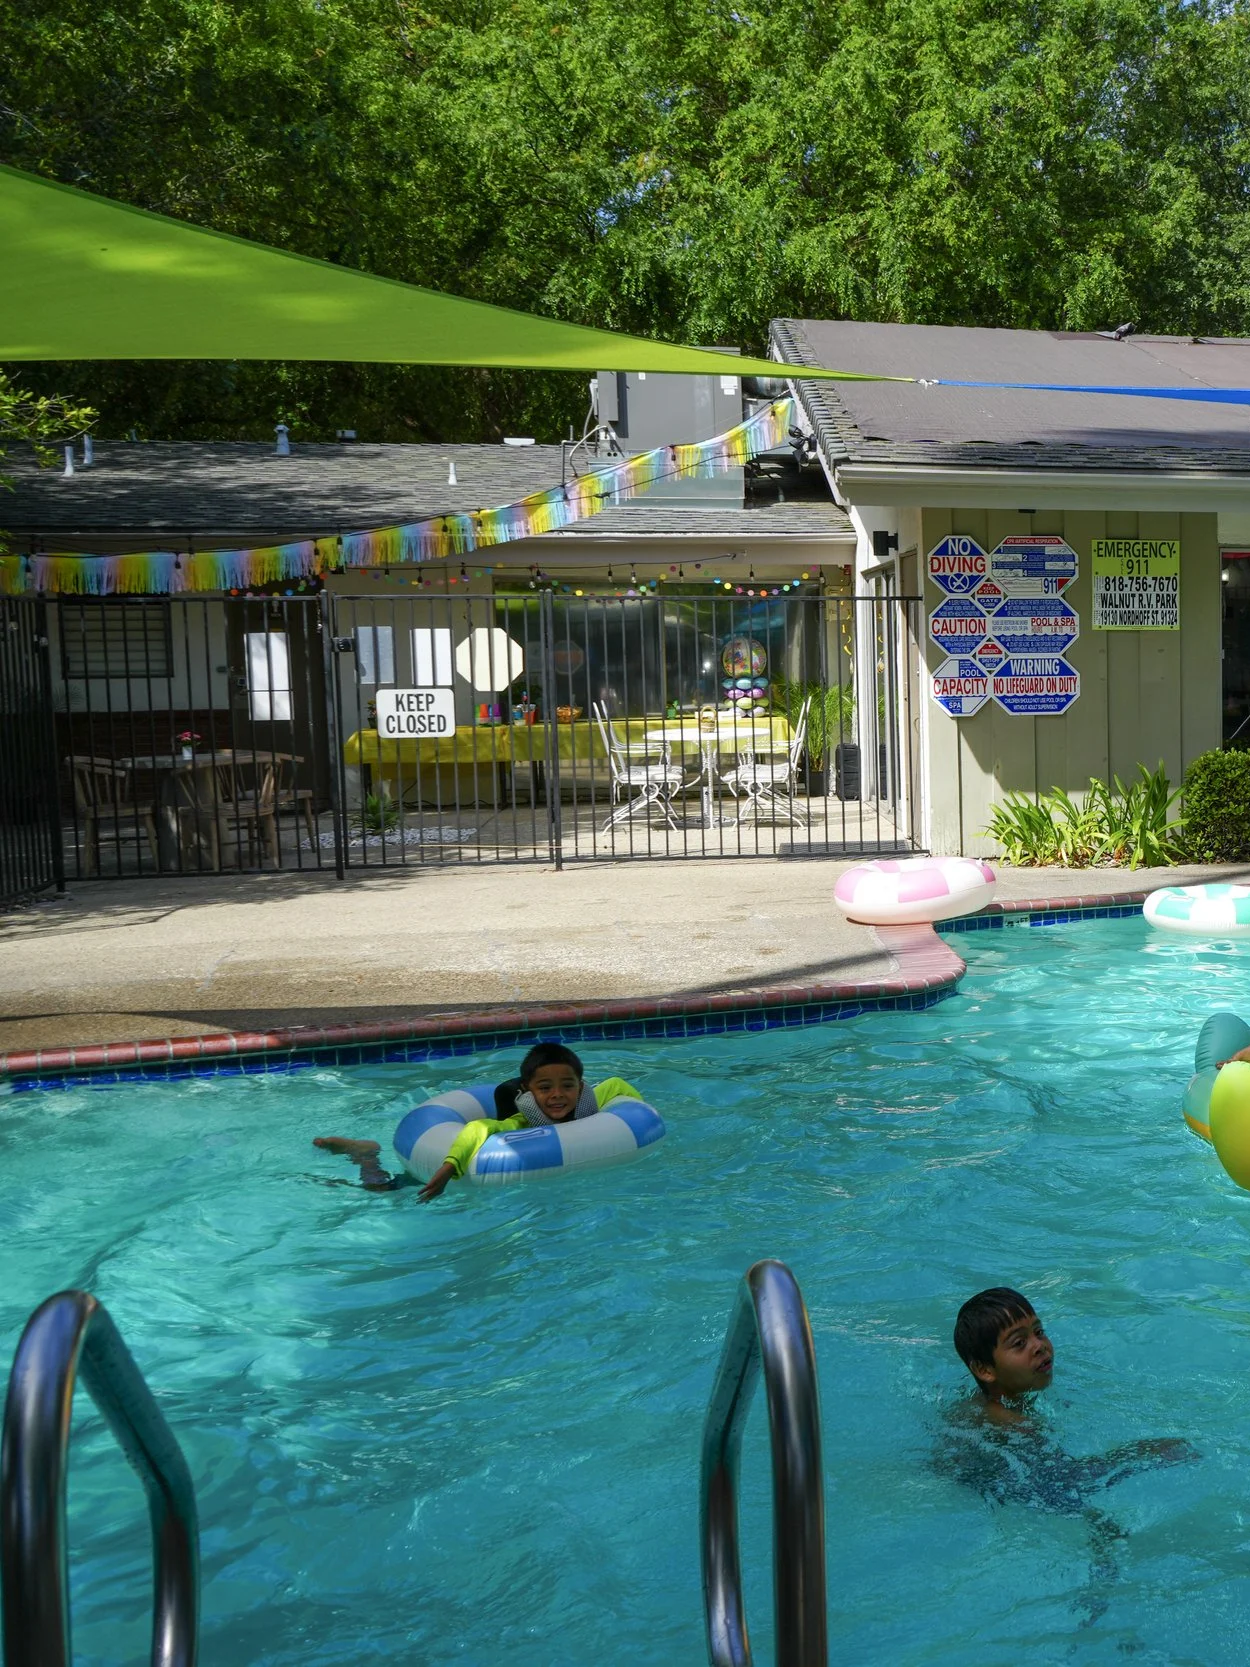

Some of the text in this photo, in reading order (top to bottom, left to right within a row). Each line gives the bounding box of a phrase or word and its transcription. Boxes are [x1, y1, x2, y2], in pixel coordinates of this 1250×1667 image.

[948, 538, 971, 555] NO
[1096, 541, 1175, 558] EMERGENCY
[930, 556, 986, 573] DIVING
[1126, 559, 1149, 575] 911
[1043, 577, 1058, 595] 911
[1104, 576, 1178, 592] 818-756-7670
[1100, 593, 1136, 609] WALNUT
[1138, 593, 1154, 609] R.V.
[1155, 593, 1177, 609] PARK
[932, 618, 986, 635] CAUTION
[1031, 617, 1052, 626] POOL
[1053, 617, 1059, 626] &
[1060, 617, 1076, 626] SPA
[1101, 610, 1178, 626] 19130 NORDHOFF ST. 91324
[960, 669, 981, 677] POOL
[1010, 659, 1060, 676] WARNING
[933, 678, 988, 695] CAPACITY
[993, 676, 1078, 695] NO LIFEGUARD ON DUTY
[395, 693, 435, 712] KEEP
[386, 714, 447, 735] CLOSED
